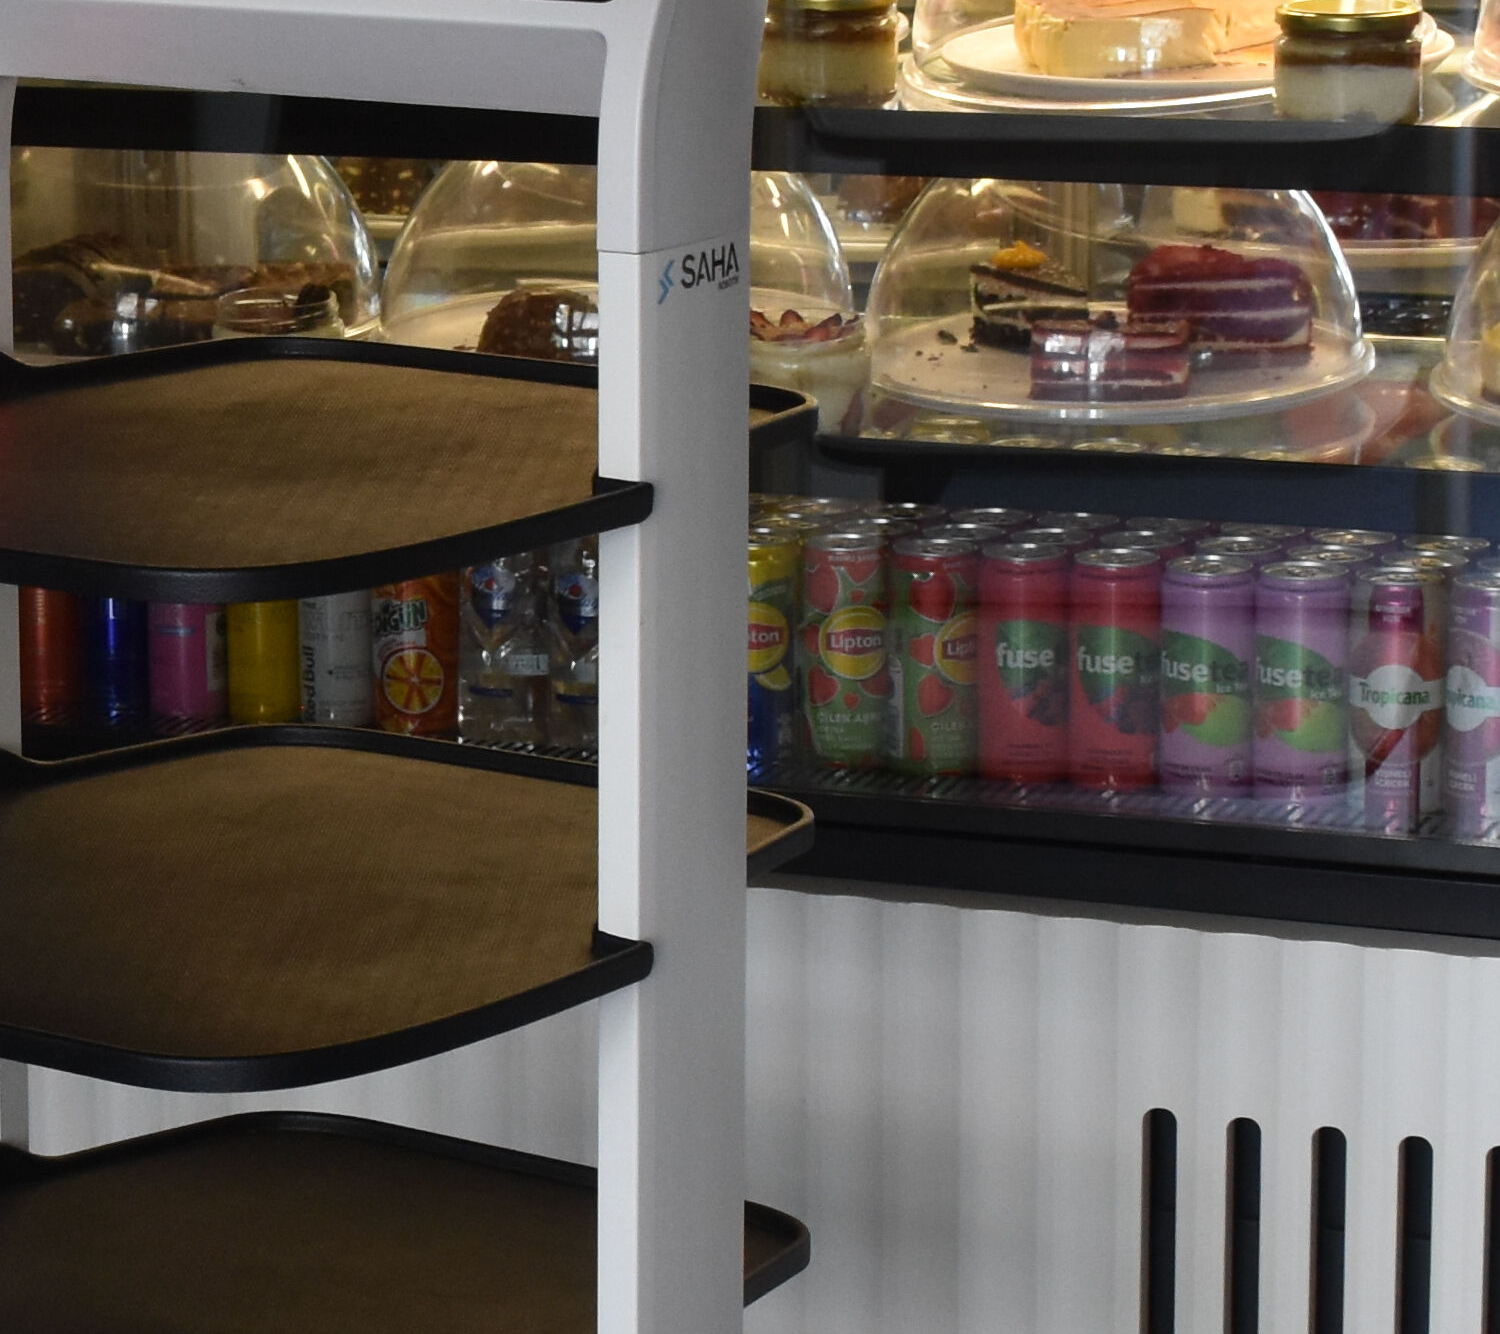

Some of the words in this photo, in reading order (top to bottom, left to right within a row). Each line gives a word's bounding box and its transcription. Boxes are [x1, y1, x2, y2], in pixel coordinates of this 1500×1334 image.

[681, 242, 739, 289] SAHA
[829, 632, 882, 651] Lipton
[1359, 681, 1430, 708] Tropicana
